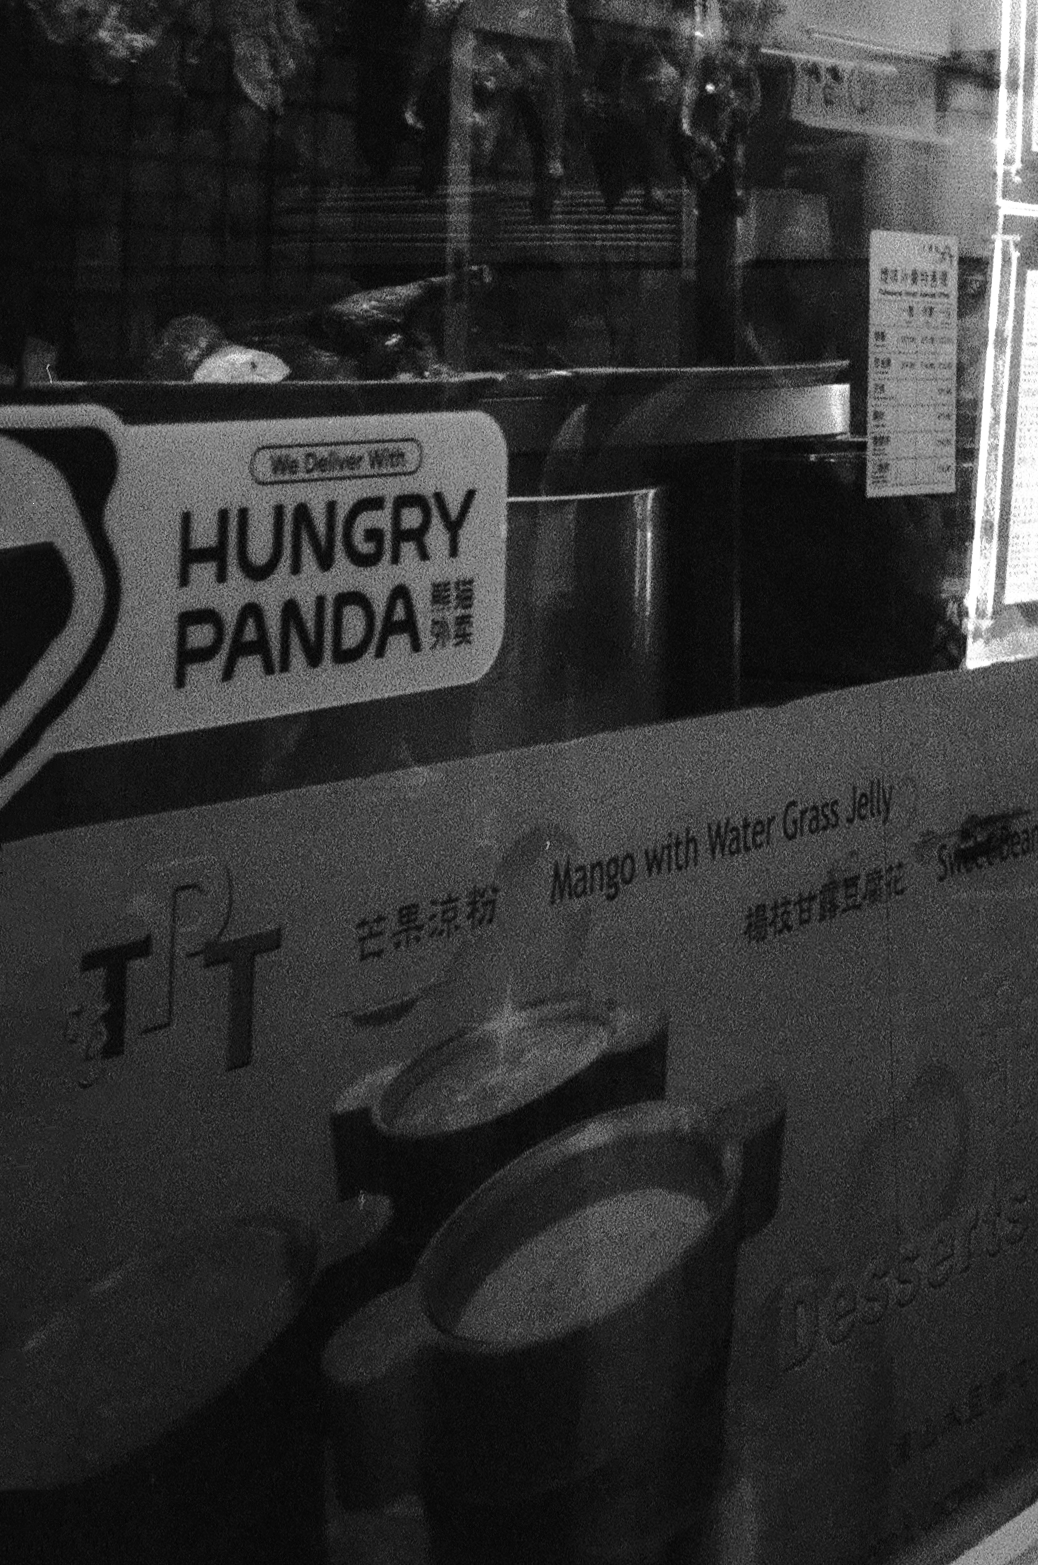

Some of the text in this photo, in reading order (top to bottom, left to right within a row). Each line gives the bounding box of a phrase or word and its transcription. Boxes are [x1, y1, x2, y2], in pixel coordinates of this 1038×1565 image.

[270, 447, 406, 474] We Deliver With
[179, 489, 477, 587] HUNGRY
[173, 584, 422, 689] PANDA
[550, 778, 895, 905] Mango with Water Grass Jelly
[356, 884, 500, 963] 芒果涼粉
[777, 1177, 1032, 1374] Desserts
